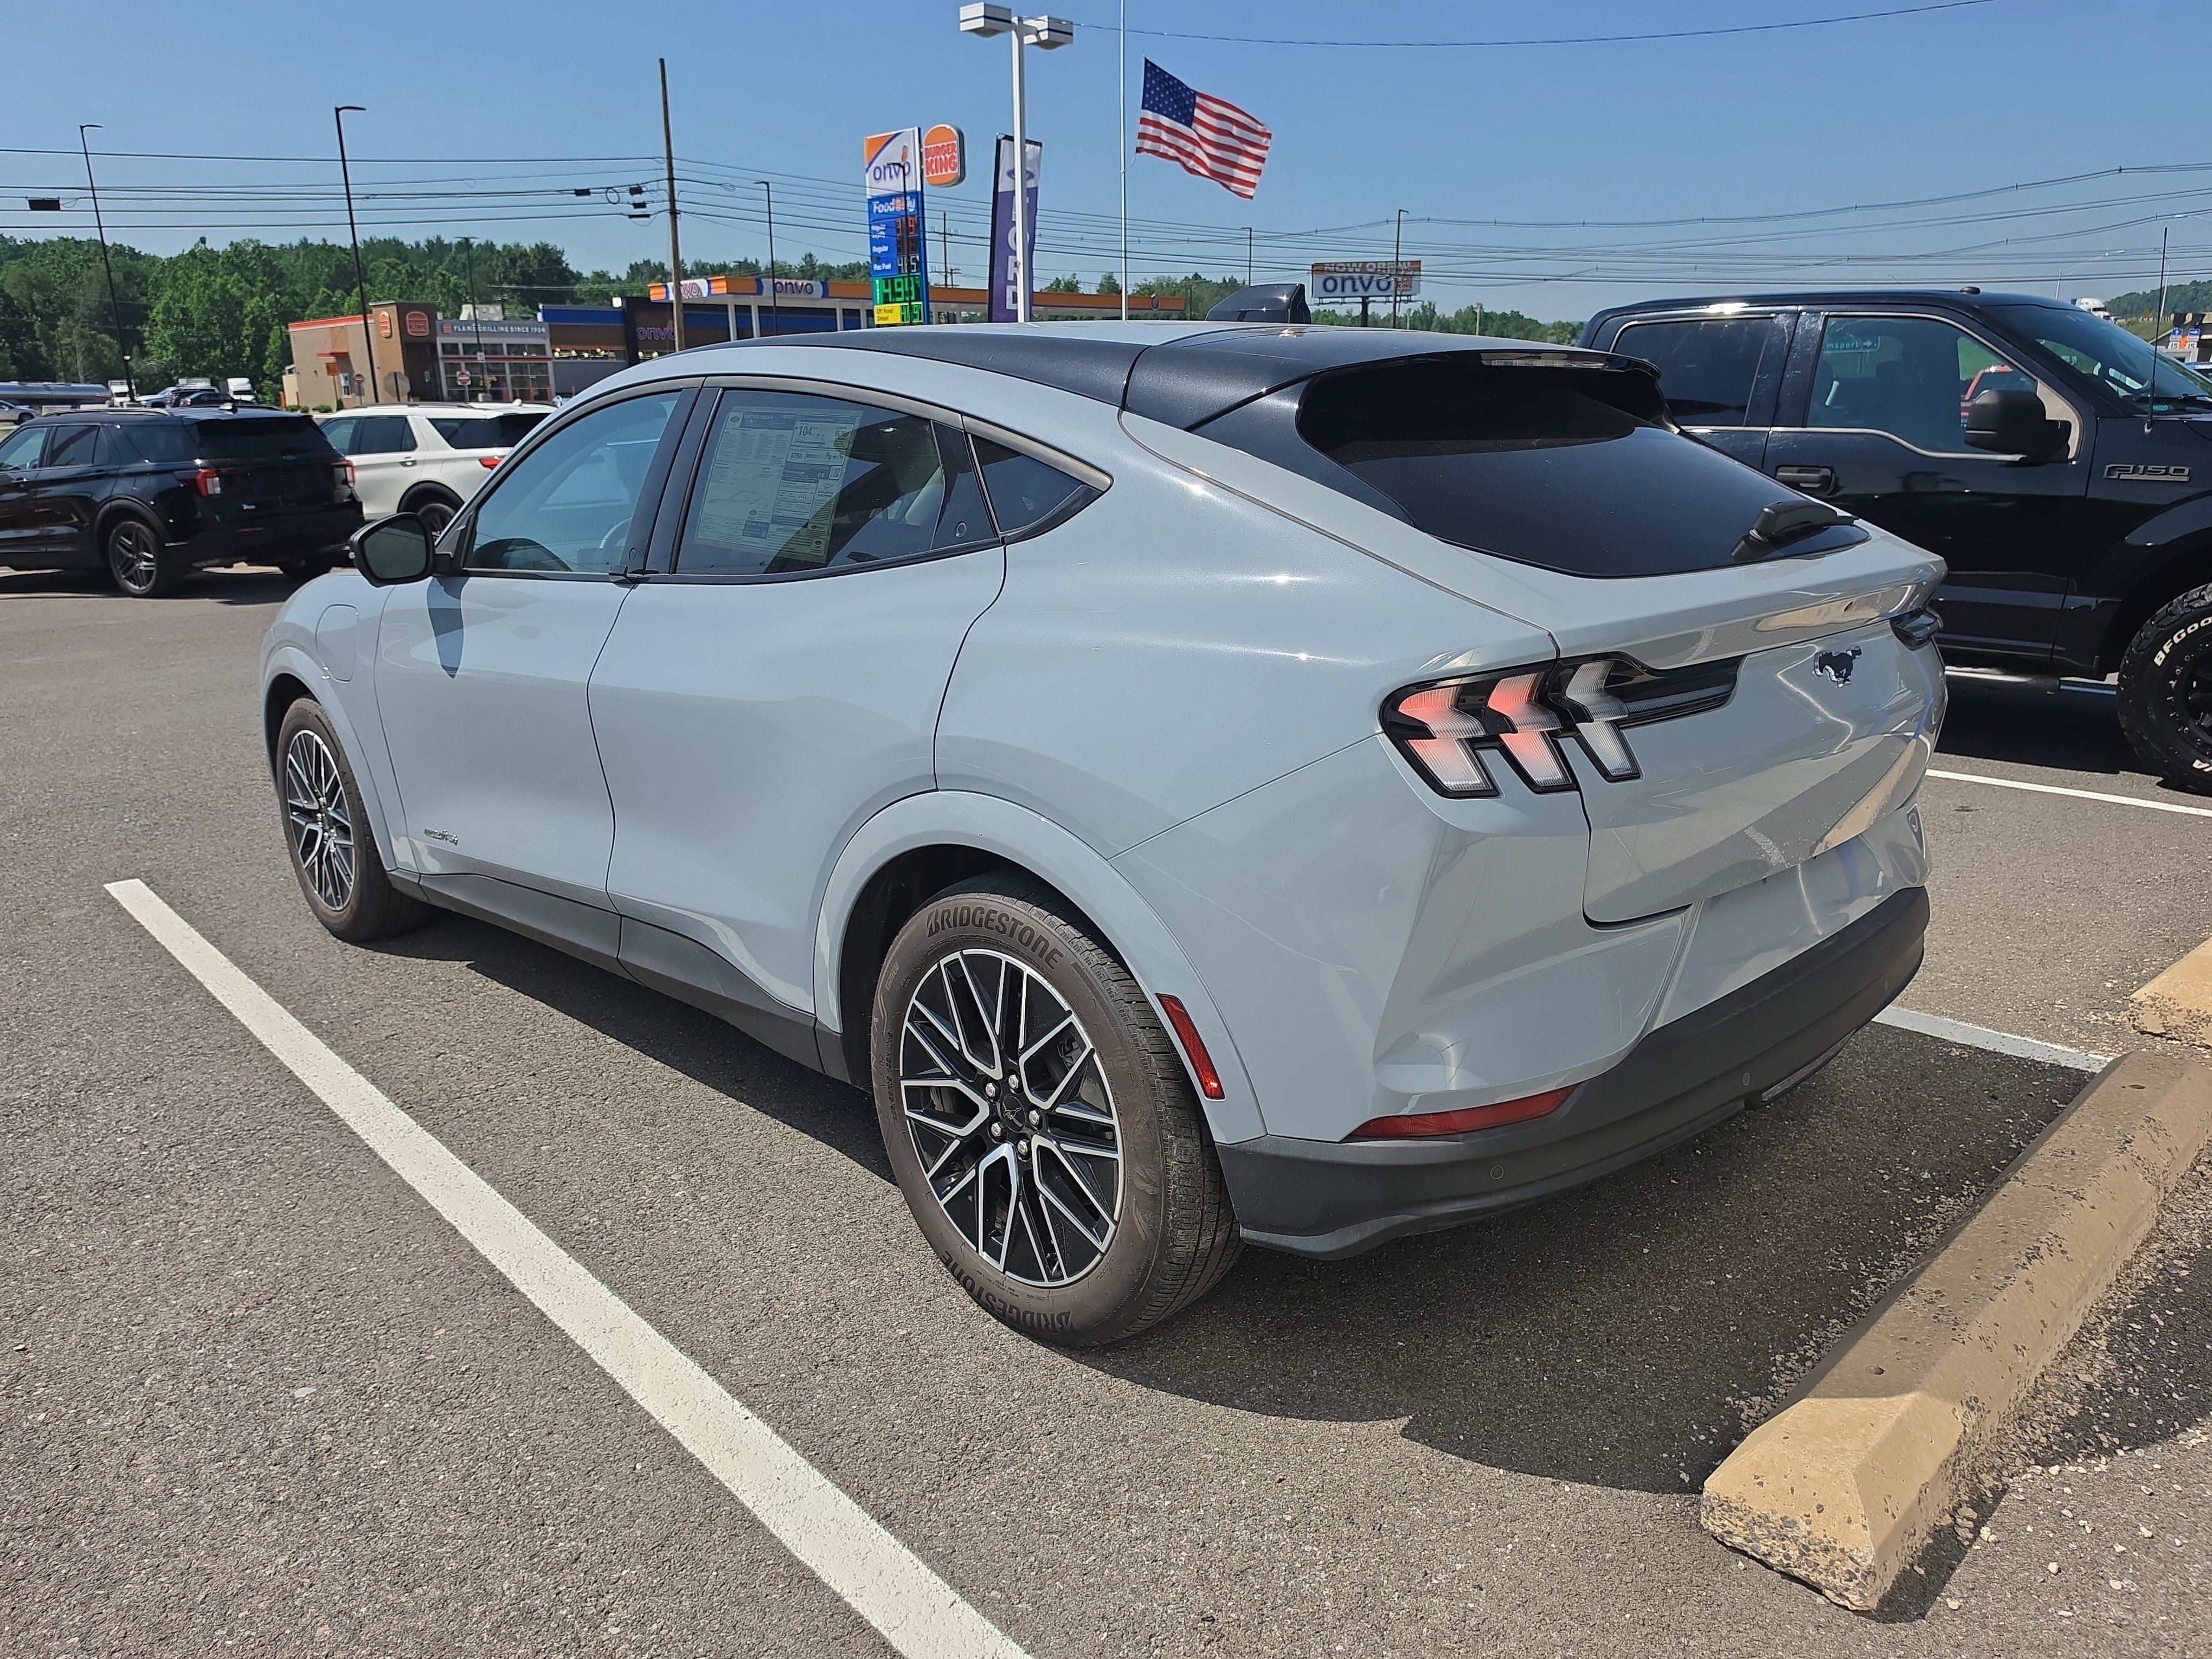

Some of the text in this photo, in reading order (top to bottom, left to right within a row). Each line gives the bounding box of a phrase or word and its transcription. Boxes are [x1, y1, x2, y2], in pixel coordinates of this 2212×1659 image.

[925, 143, 955, 158] BURGER
[925, 155, 957, 176] KING
[1323, 261, 1410, 273] NOW OPEN
[774, 281, 814, 294] onvo
[1322, 275, 1392, 293] onvo
[799, 426, 813, 437] 104
[926, 905, 1064, 970] BRIDGESTONE
[942, 1250, 1082, 1334] BRIDGESTONE
